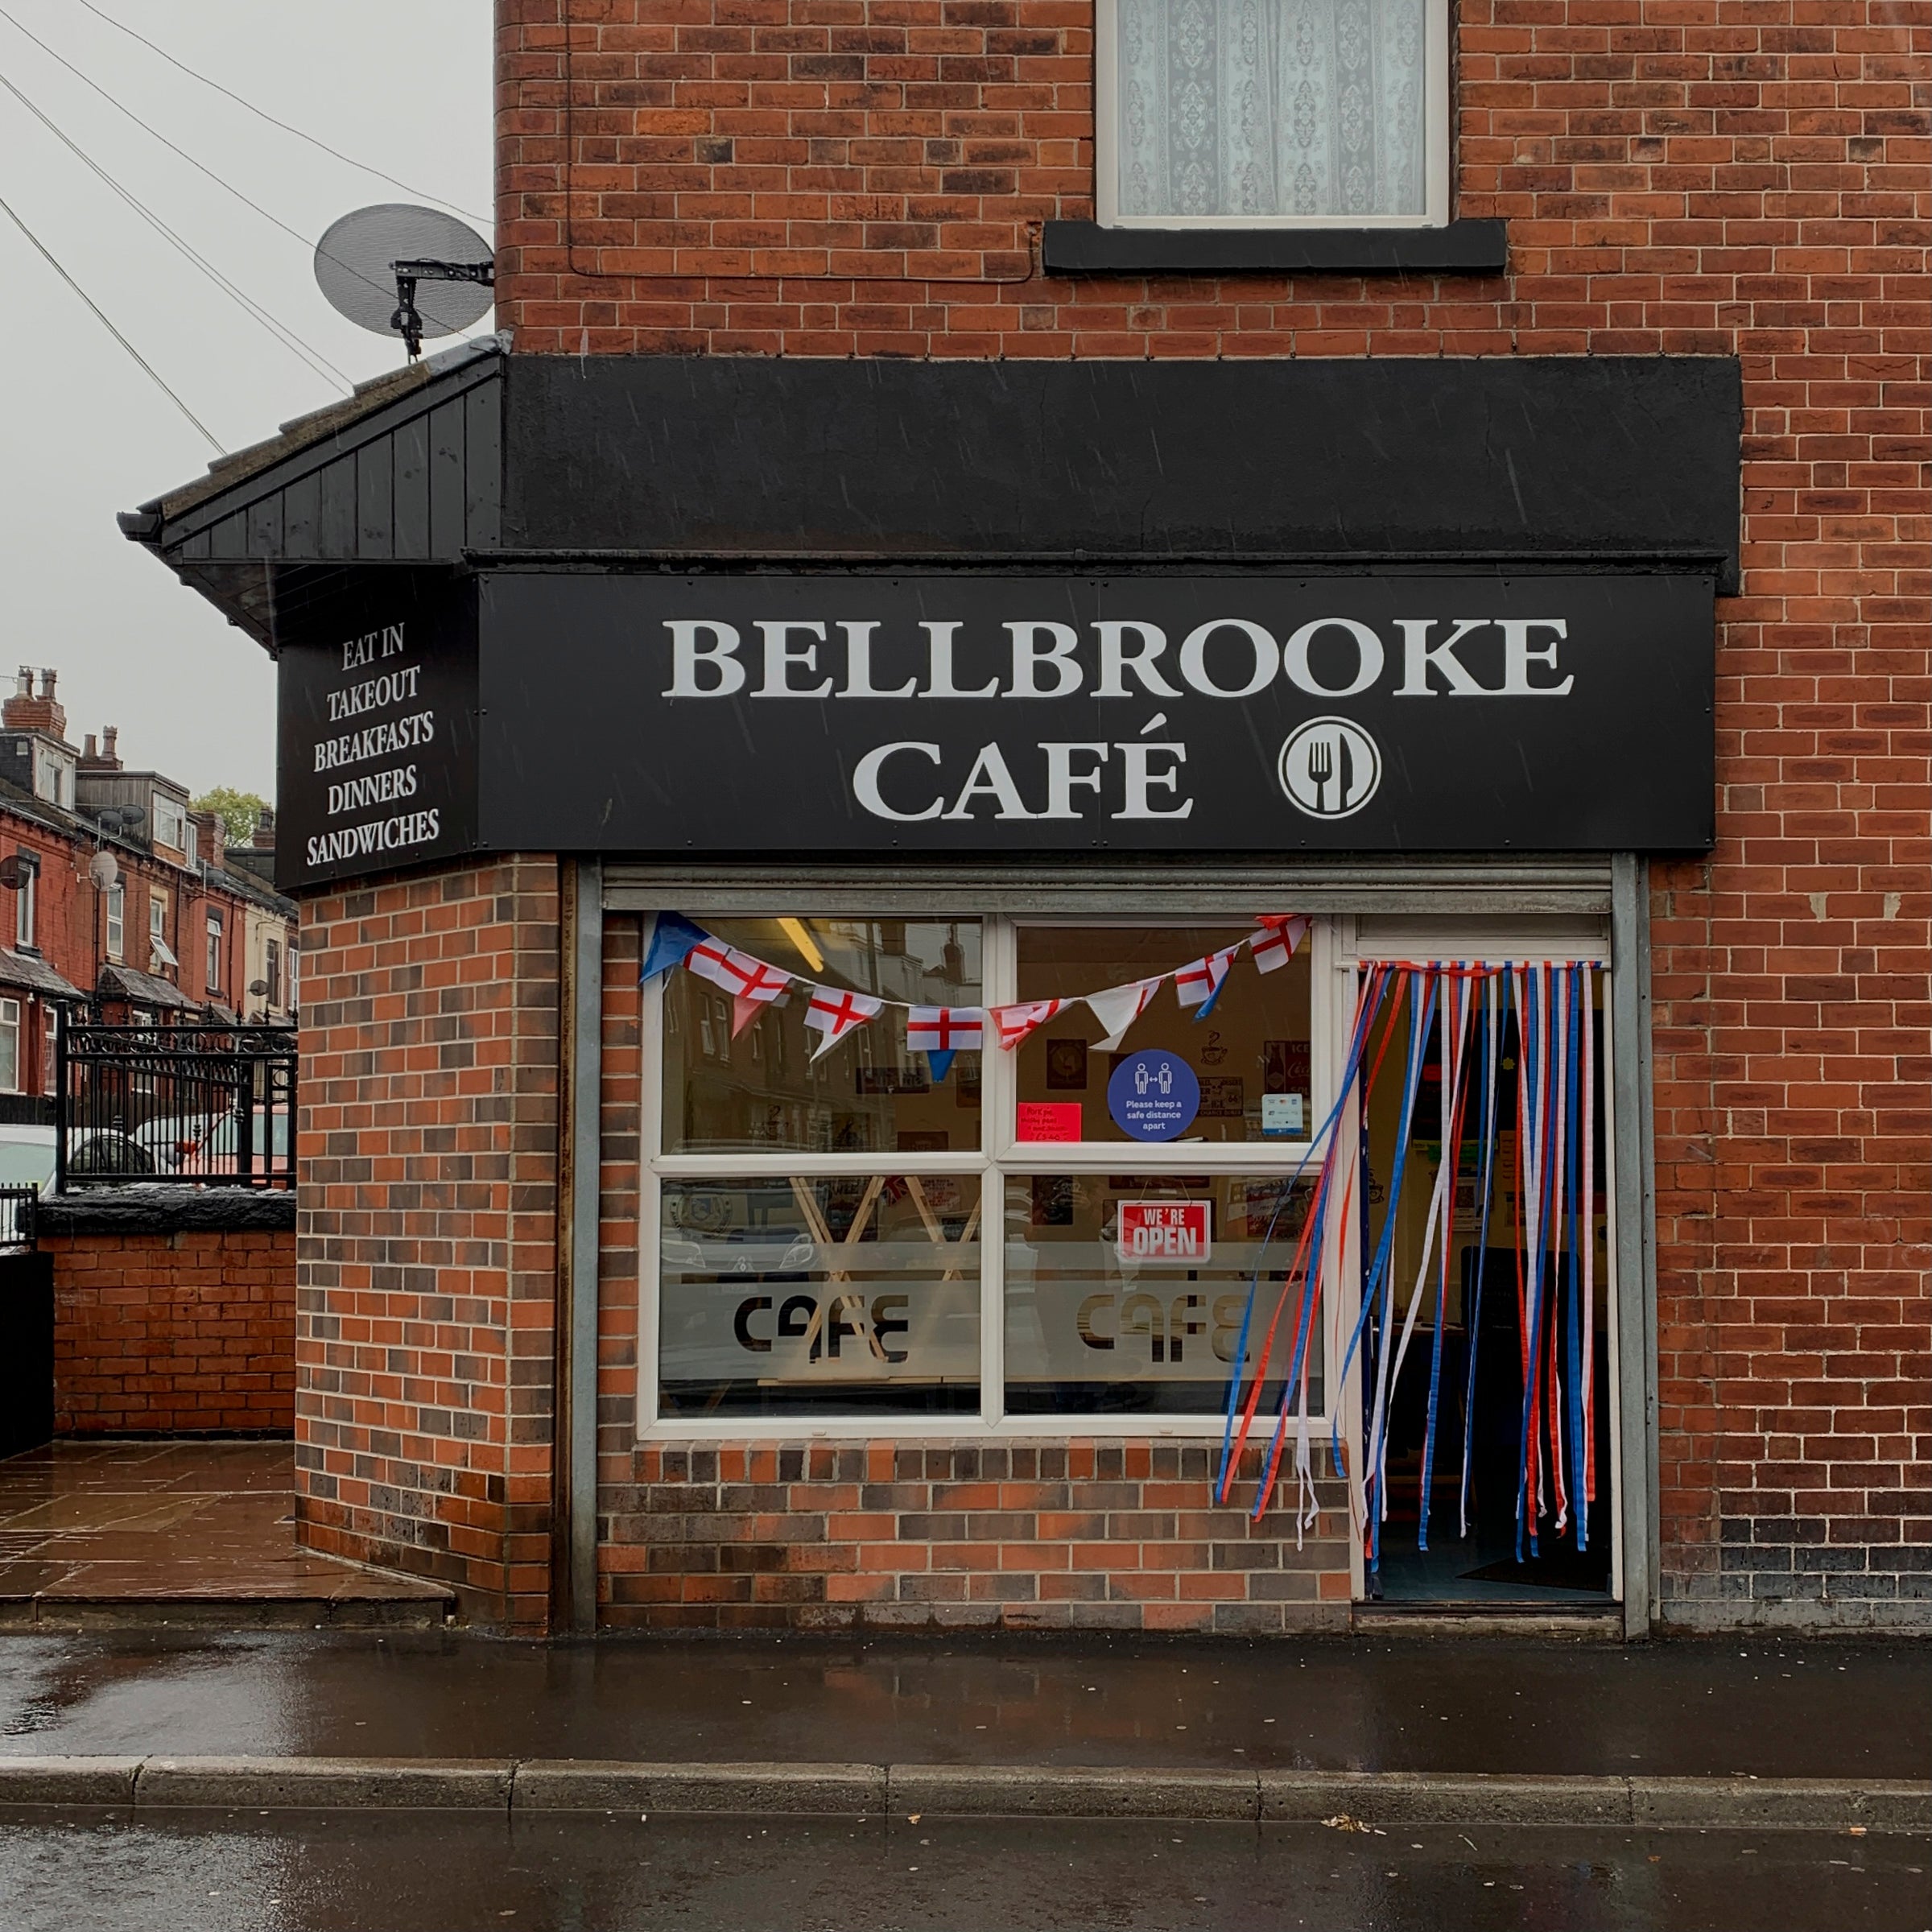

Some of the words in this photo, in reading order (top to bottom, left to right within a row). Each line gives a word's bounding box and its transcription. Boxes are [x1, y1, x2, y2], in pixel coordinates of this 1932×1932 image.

[341, 632, 378, 671] EAT
[381, 622, 405, 658] IN
[662, 618, 1575, 698] BELLBROOKE
[326, 665, 420, 721] TAKEOUT
[313, 711, 434, 773] BREAKFASTS
[853, 712, 1194, 821] CAFÉ
[327, 764, 417, 815] DINNERS
[307, 808, 440, 867] SANDWICHES
[1127, 1111, 1144, 1119] safe
[1146, 1111, 1181, 1119] distance
[1142, 1122, 1166, 1131] apart
[1154, 1100, 1174, 1109] keep
[1133, 1227, 1196, 1255] OPEN
[1144, 1208, 1184, 1225] WE'RE
[733, 1294, 908, 1364] CAFE
[1077, 1294, 1250, 1363] CAFE
